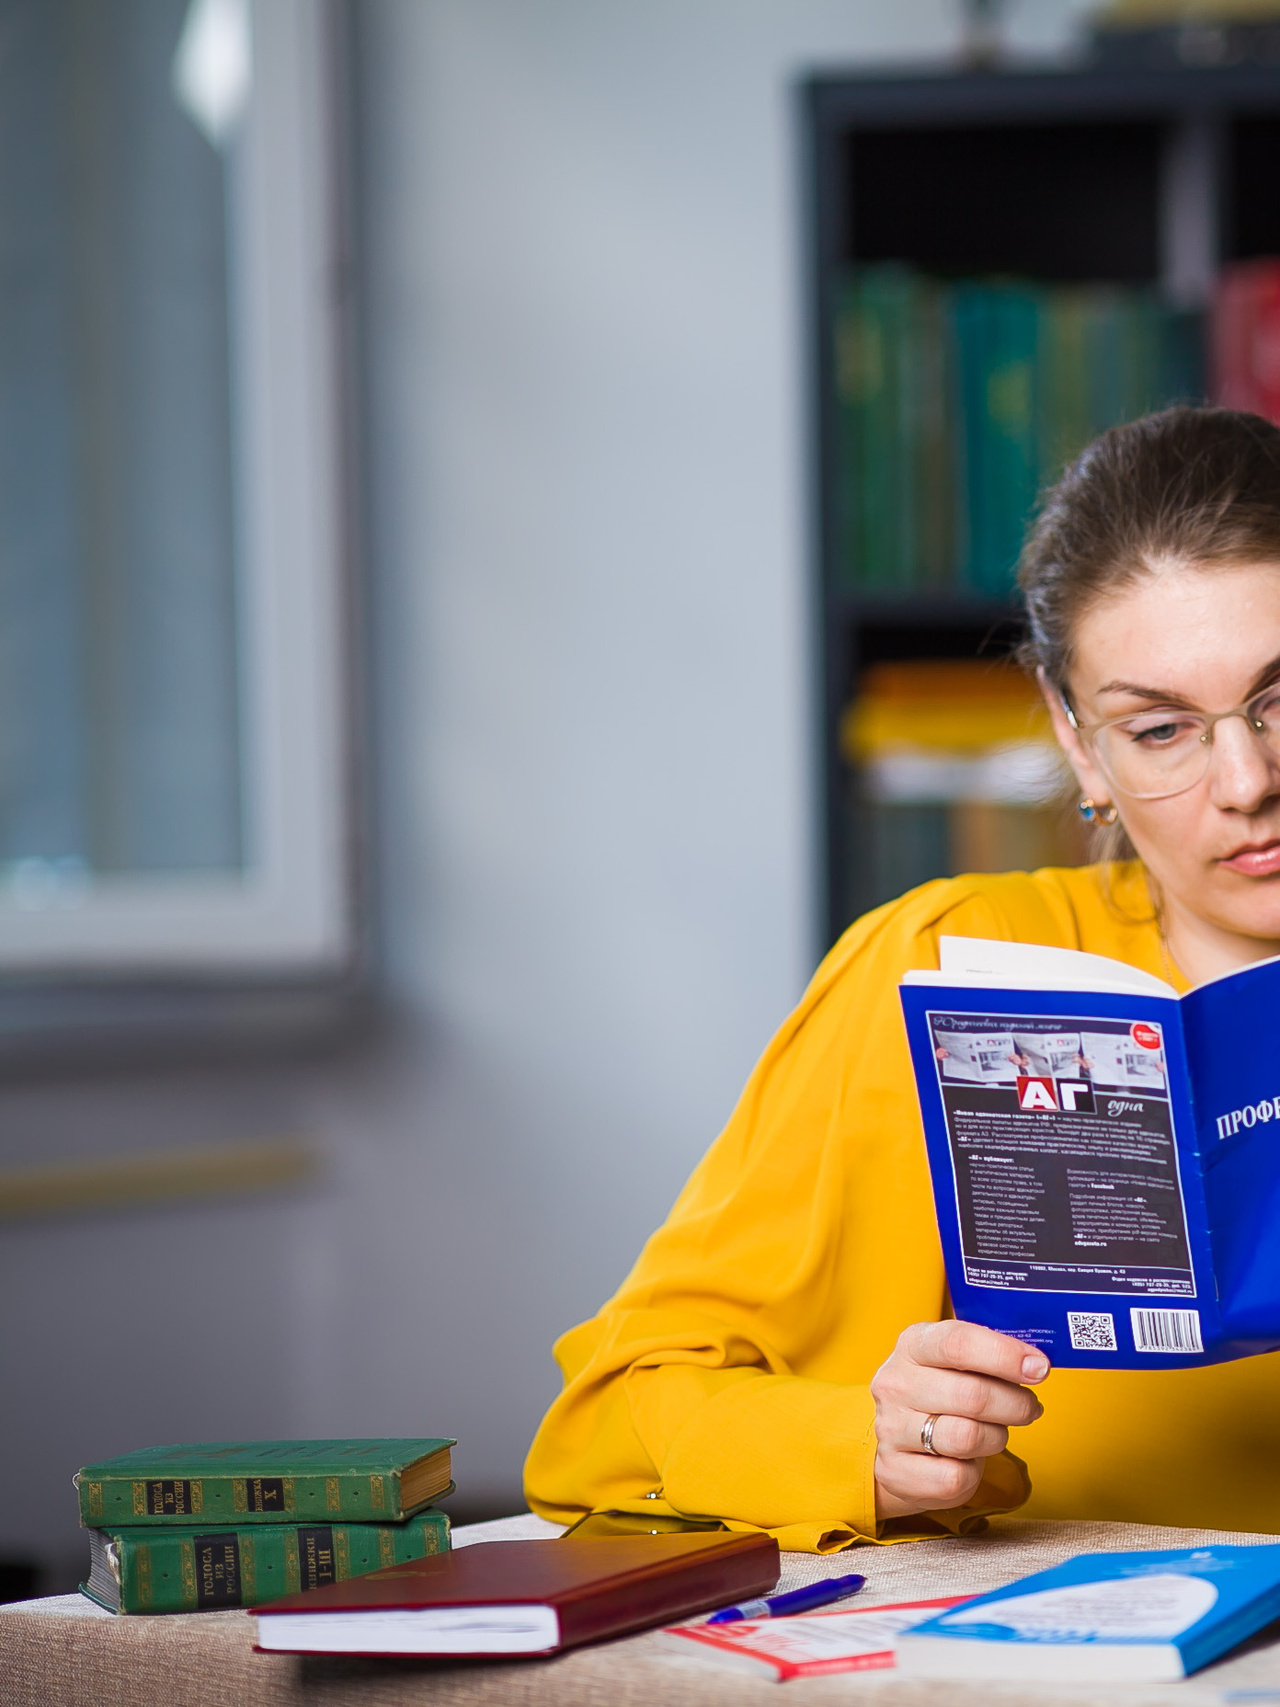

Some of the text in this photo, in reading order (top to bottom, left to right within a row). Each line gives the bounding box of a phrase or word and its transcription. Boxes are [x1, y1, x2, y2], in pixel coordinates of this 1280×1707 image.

[1021, 1081, 1143, 1117] АГ одна
[153, 1482, 164, 1514] ГОЛОСА
[165, 1492, 174, 1504] ИЗ
[174, 1480, 185, 1514] РОССИИ
[254, 1479, 263, 1512] КНИЖКА
[202, 1547, 214, 1596] ГОЛОСА
[215, 1563, 224, 1579] ИЗ
[224, 1545, 236, 1594] РОССИИ
[306, 1537, 317, 1590] КНИЖКИ
